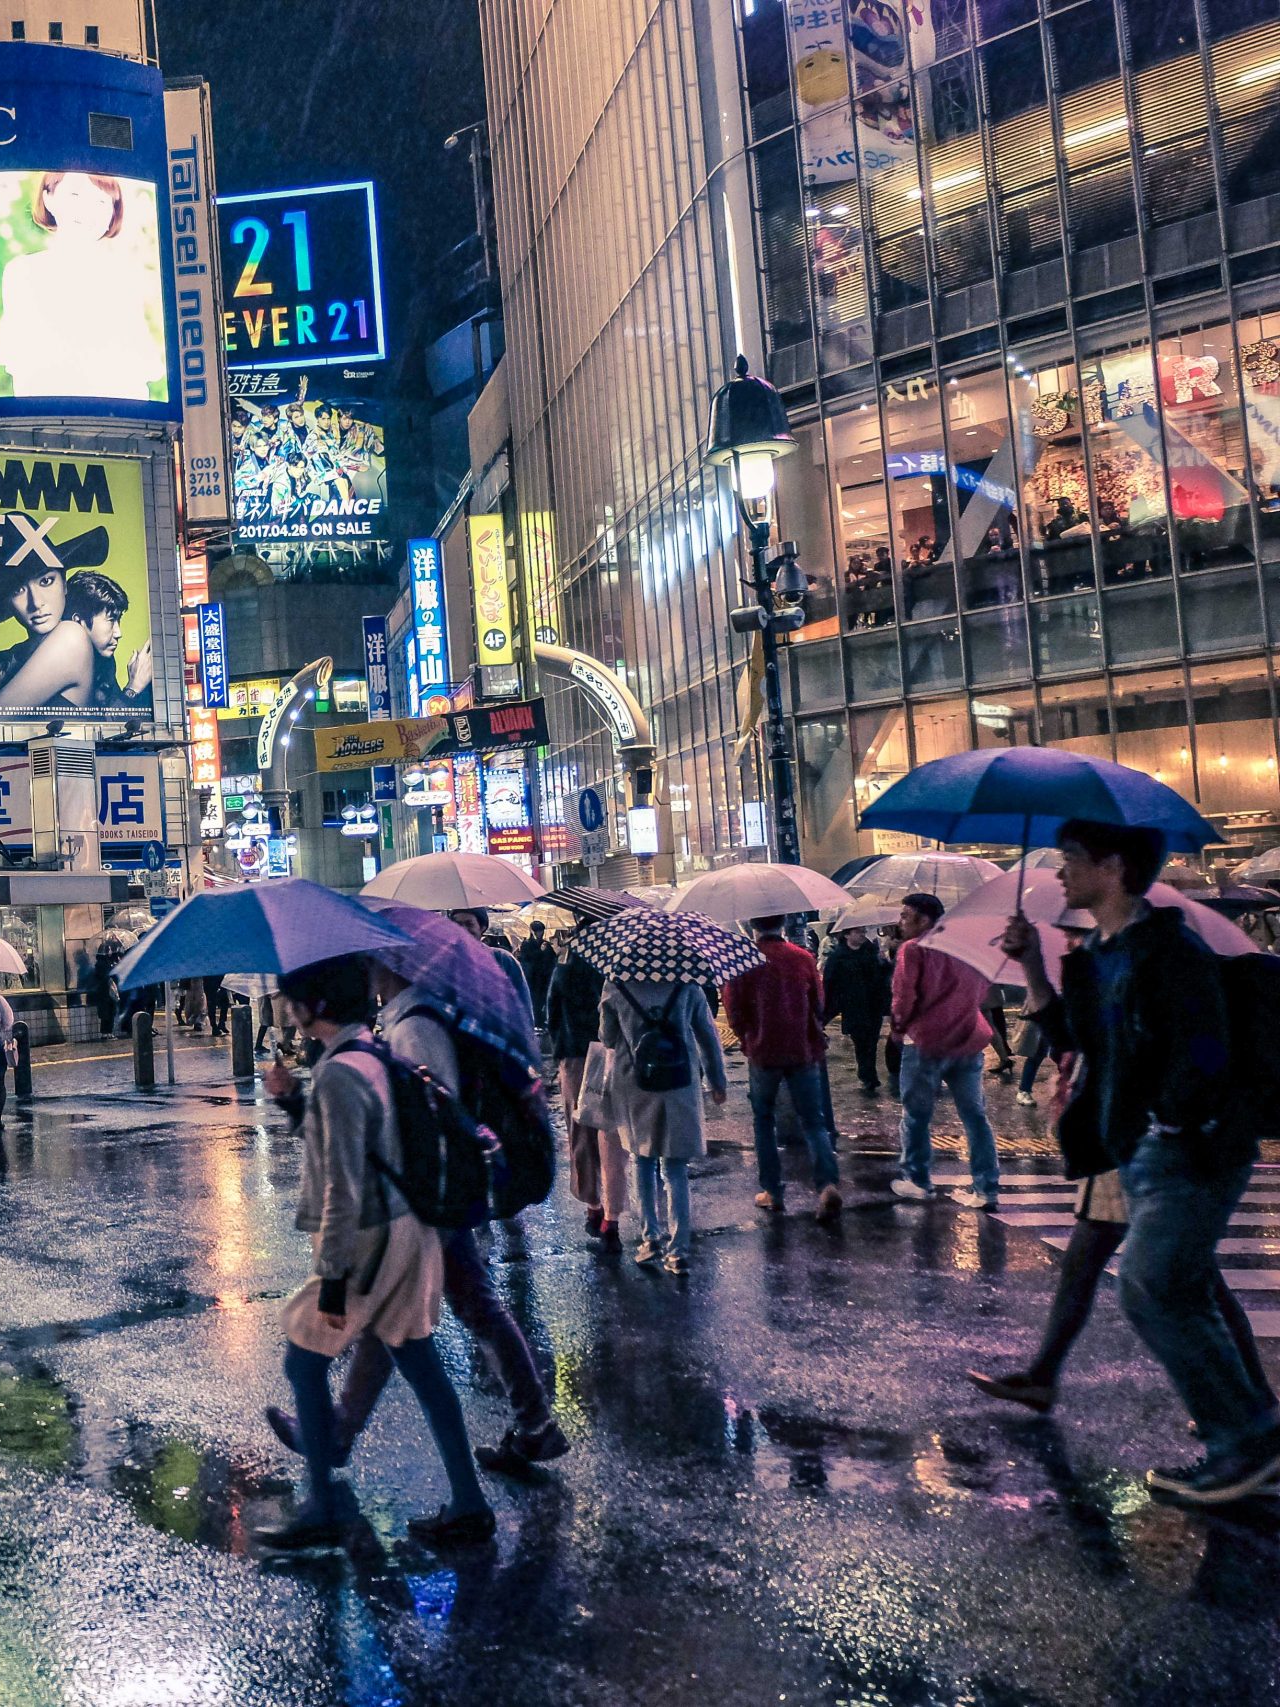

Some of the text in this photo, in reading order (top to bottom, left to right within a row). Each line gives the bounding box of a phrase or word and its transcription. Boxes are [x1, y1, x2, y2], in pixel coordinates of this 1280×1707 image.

[230, 209, 313, 299] 21
[168, 134, 209, 409] Taisei neon
[327, 299, 368, 342] 21
[189, 456, 217, 471] (03)
[189, 471, 220, 485] 3719
[189, 484, 221, 497] 2468
[238, 521, 372, 539] 2017.04.26 ON SALE
[413, 548, 444, 686] 洋服の青山
[484, 631, 506, 648] 4F
[203, 609, 225, 704] 大盛堂商事ビル
[576, 664, 630, 738] 渋谷センター街
[259, 687, 292, 766] 渋谷センター街
[100, 829, 159, 839] BOOKS TAISEIDO
[508, 835, 532, 843] PANIC
